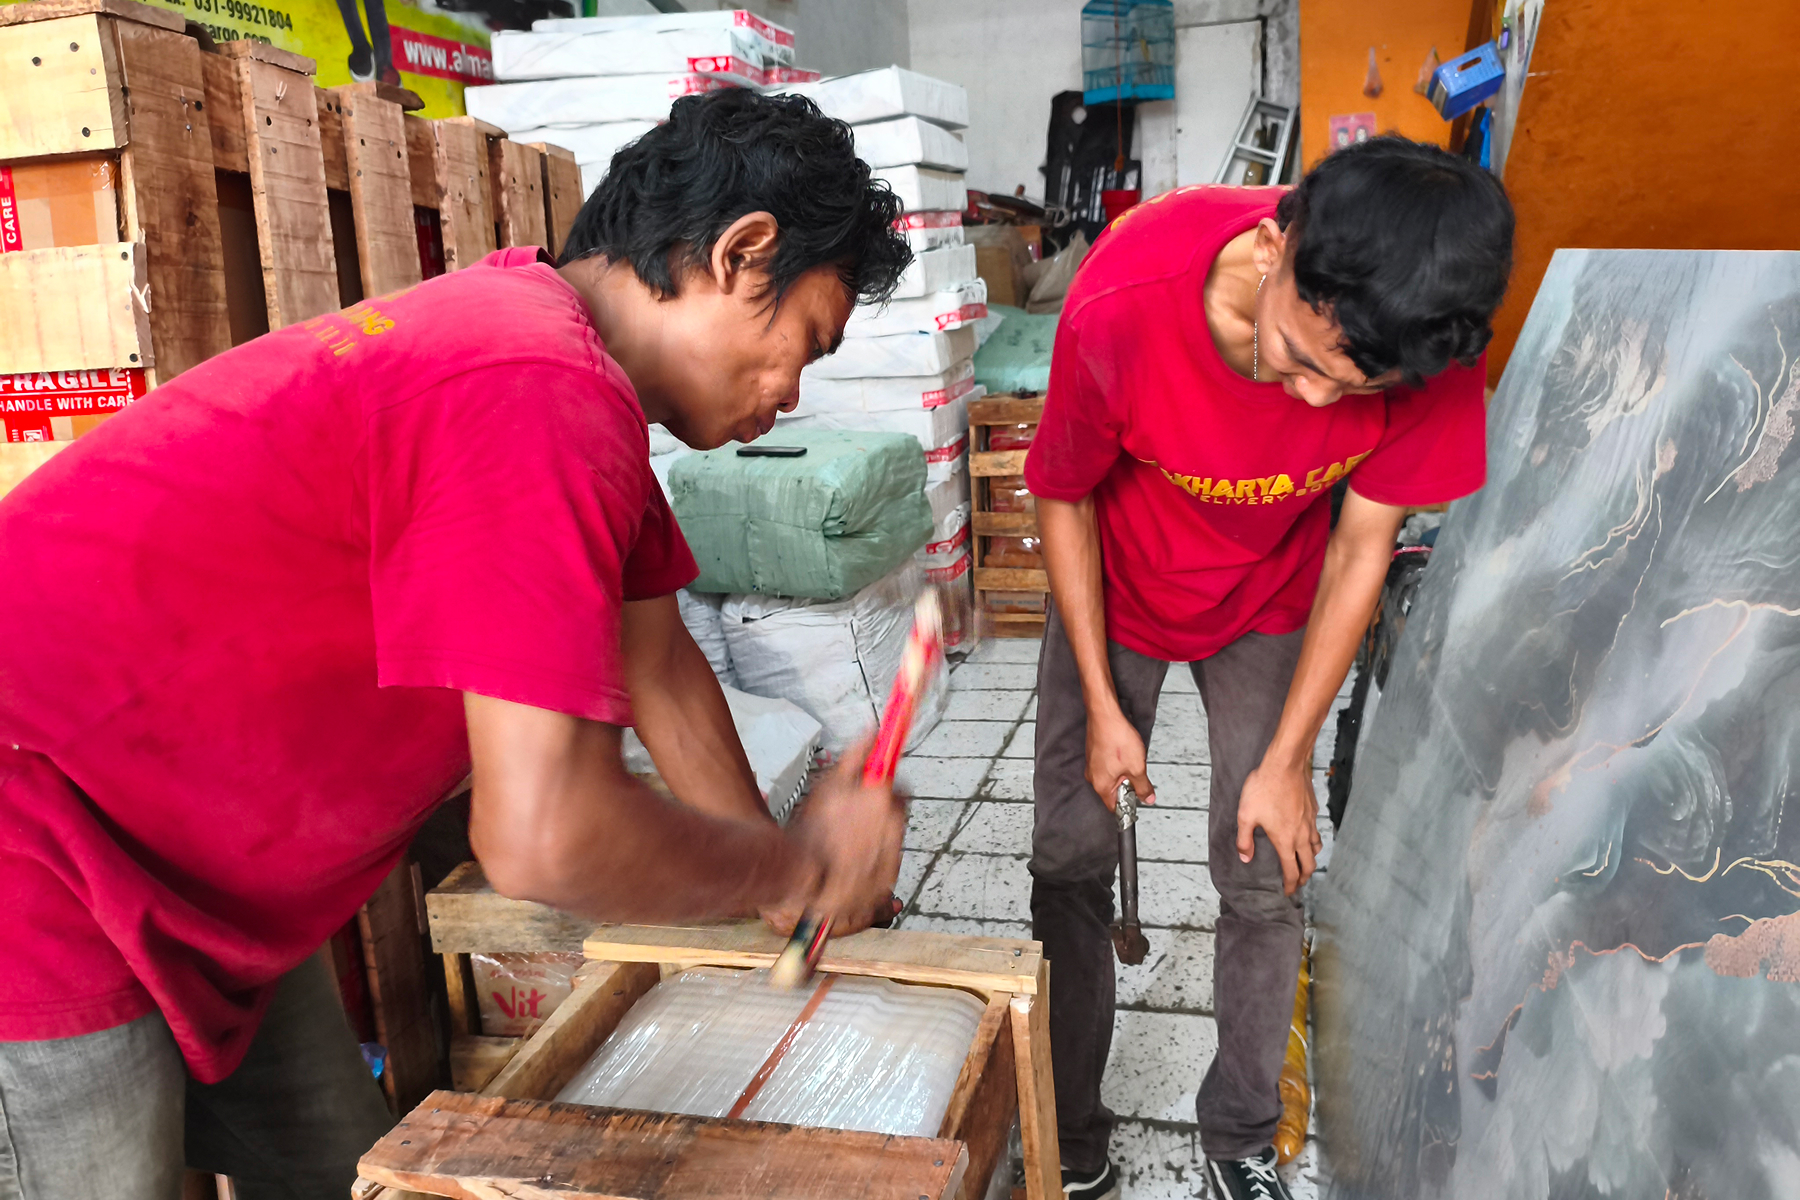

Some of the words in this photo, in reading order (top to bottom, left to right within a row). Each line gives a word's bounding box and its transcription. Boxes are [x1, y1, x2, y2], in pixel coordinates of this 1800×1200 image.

[194, 0, 293, 31] 031-99921804
[1, 196, 17, 244] CARE
[0, 369, 127, 391] FRAGILE
[0, 398, 52, 412] HANDLE
[57, 396, 93, 410] WITH
[1192, 491, 1289, 505] ELIVERY
[492, 985, 547, 1019] Vit
